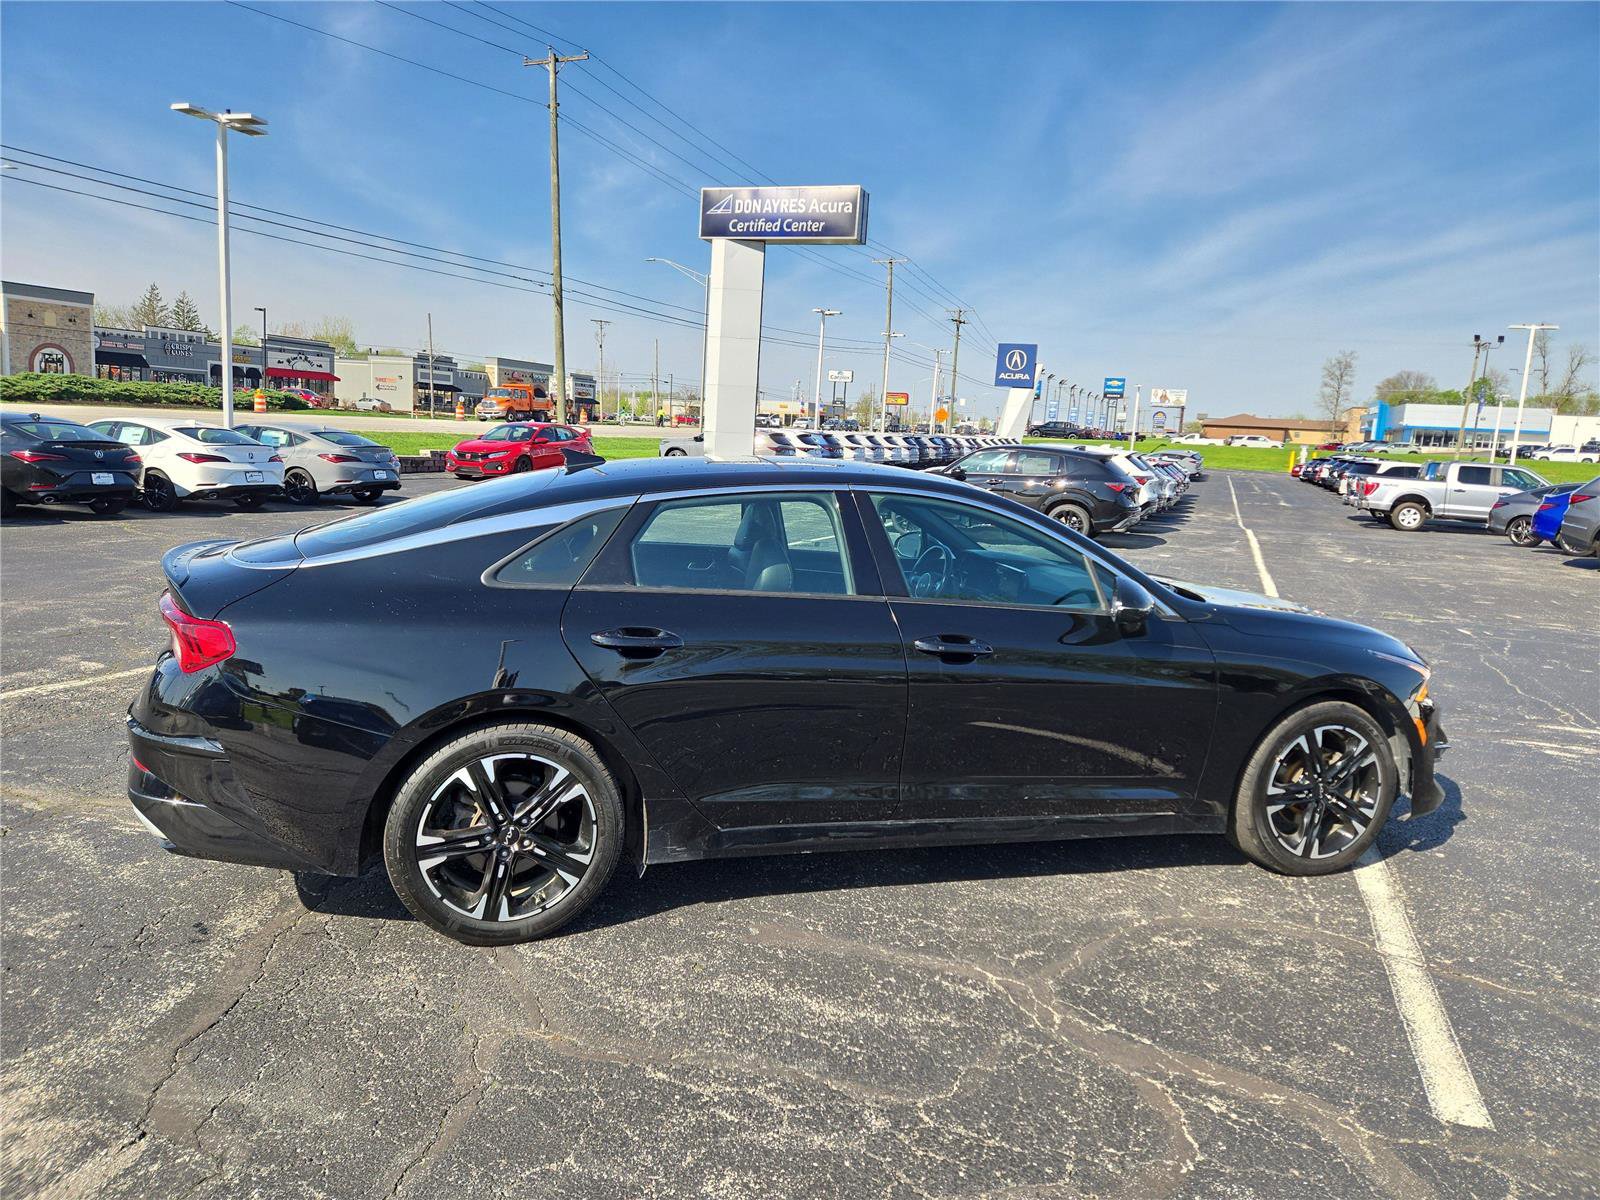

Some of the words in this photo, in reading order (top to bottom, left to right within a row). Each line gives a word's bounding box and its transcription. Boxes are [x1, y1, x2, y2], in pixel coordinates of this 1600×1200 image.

[734, 199, 762, 214] DON
[763, 198, 806, 213] AYRES
[808, 198, 853, 213] Acura
[729, 218, 781, 233] Certified
[782, 218, 825, 232] Center
[998, 372, 1030, 380] ACURA
